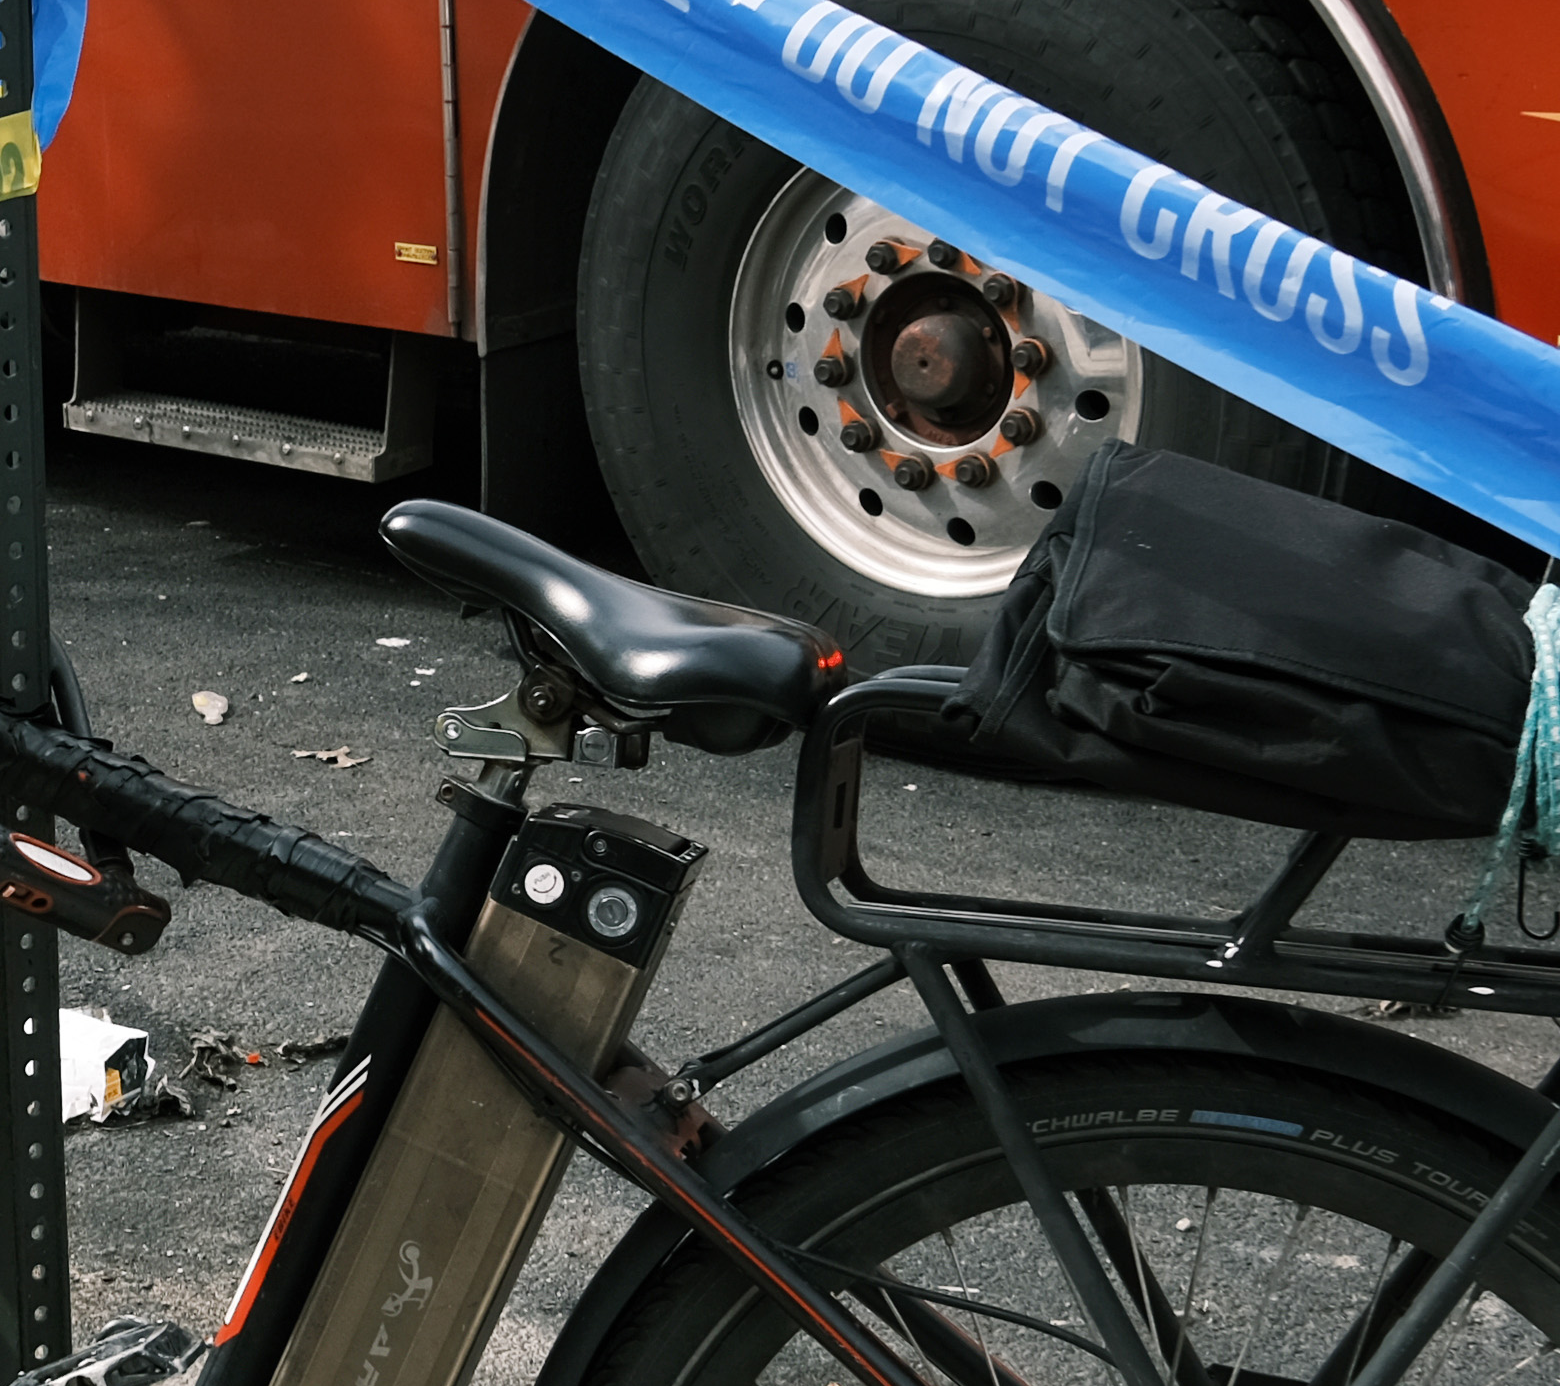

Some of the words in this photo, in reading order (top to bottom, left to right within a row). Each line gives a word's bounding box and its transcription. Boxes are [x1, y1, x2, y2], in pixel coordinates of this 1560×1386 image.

[917, 67, 1106, 213] NOT
[1120, 162, 1455, 387] CROSS
[1309, 1129, 1400, 1165] PLUS
